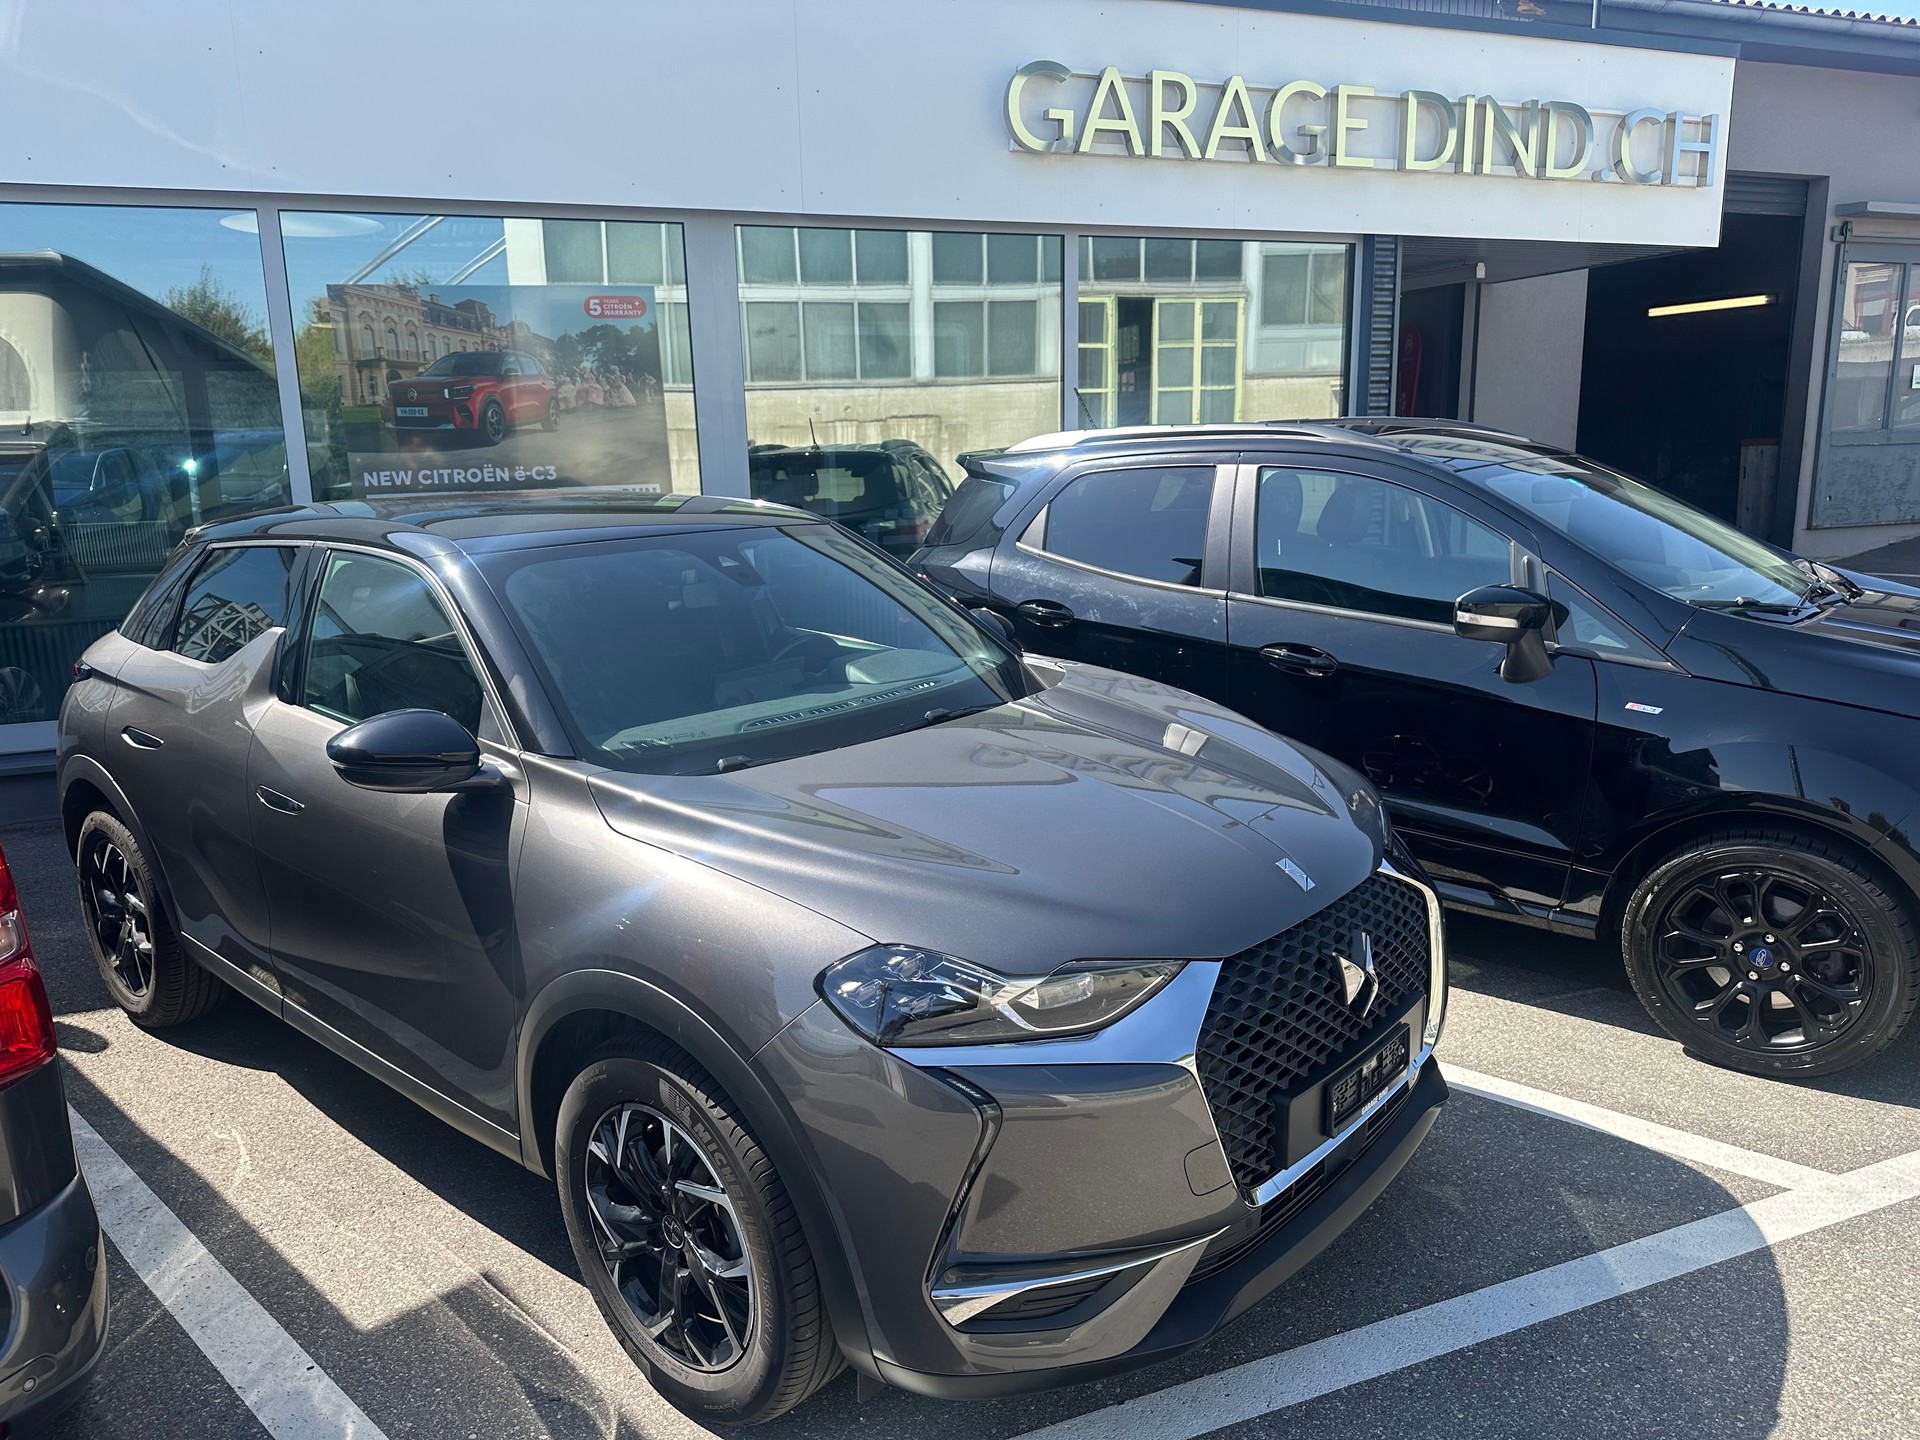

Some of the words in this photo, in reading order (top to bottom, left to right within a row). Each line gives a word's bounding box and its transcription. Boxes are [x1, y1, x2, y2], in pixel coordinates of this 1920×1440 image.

[1007, 60, 1376, 169] GARAGE
[589, 299, 601, 316] 5
[363, 470, 413, 487] NEW
[418, 464, 510, 485] CITROËN
[515, 466, 557, 481] ë-C3
[1361, 1095, 1379, 1115] GARAGE
[694, 1122, 761, 1240] MICHELIN
